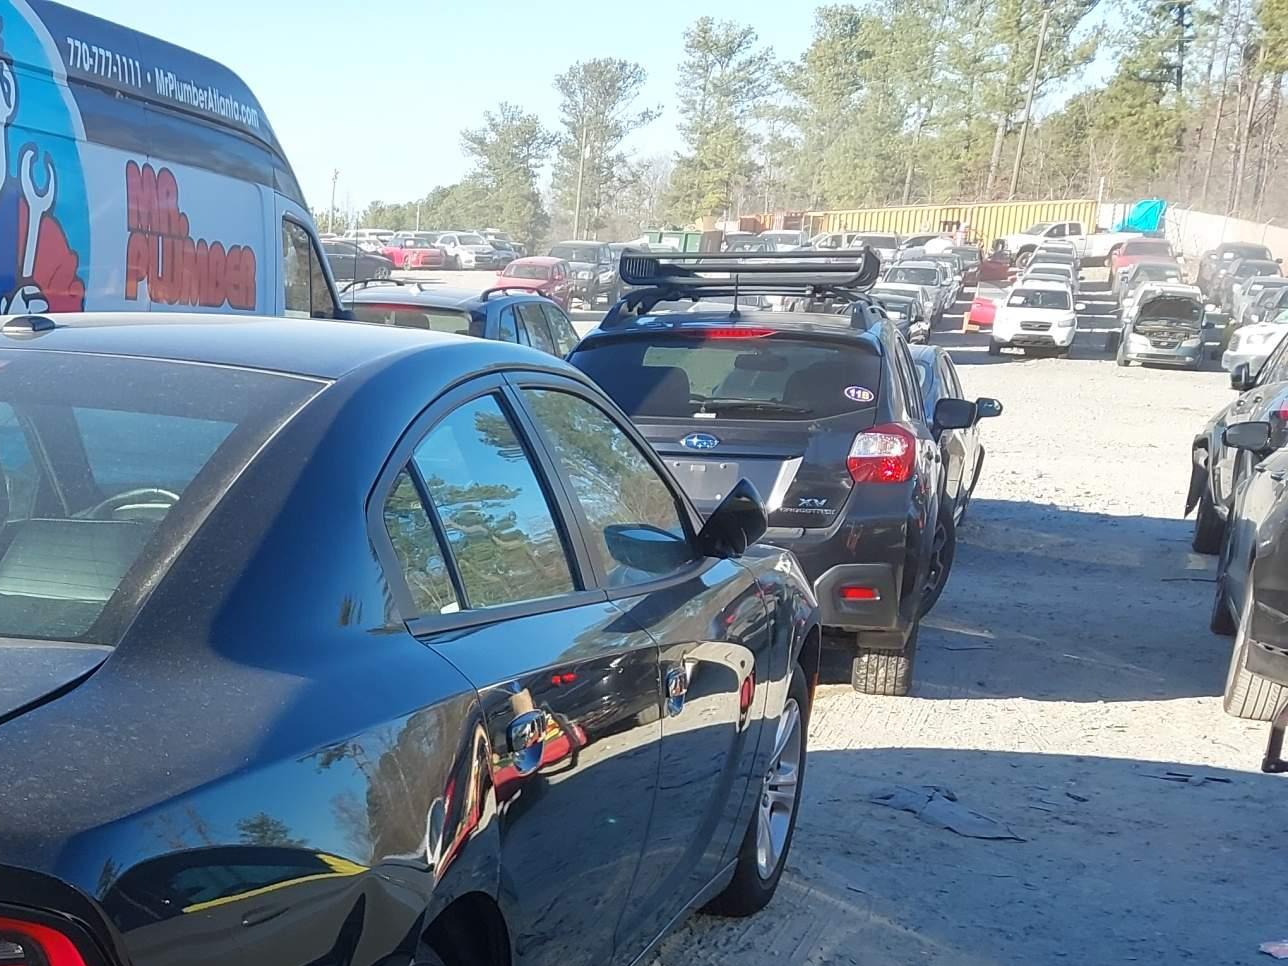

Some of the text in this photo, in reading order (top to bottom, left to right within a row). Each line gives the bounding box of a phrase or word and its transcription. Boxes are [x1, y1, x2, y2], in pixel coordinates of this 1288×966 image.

[66, 37, 260, 128] 770-777-1111 MrPlumberAtlanta.com
[798, 498, 828, 507] XV
